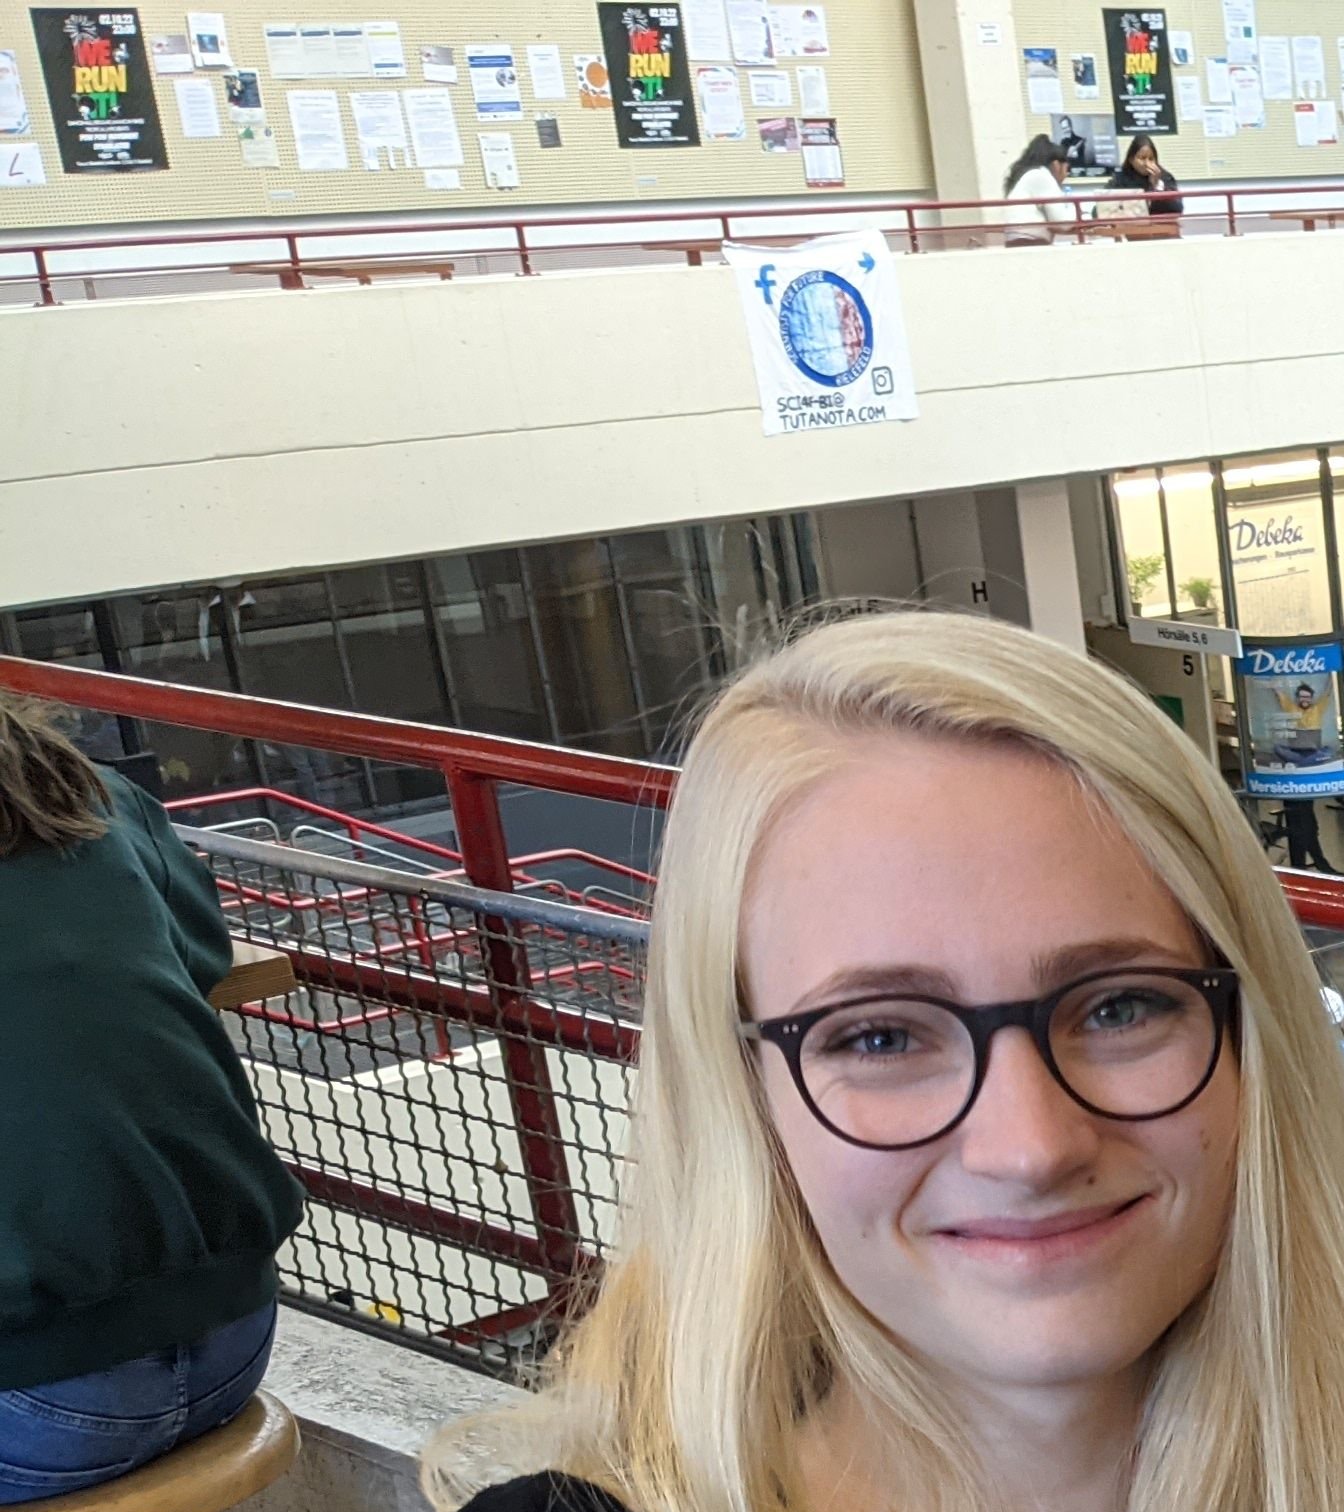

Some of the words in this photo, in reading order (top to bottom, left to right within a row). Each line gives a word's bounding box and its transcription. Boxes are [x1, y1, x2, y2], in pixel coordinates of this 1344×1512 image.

[73, 39, 112, 66] WE
[628, 53, 670, 78] RUN
[74, 65, 127, 93] RUN
[1228, 515, 1304, 551] Debeka
[1183, 654, 1194, 676] 5
[1248, 649, 1326, 674] Debeka
